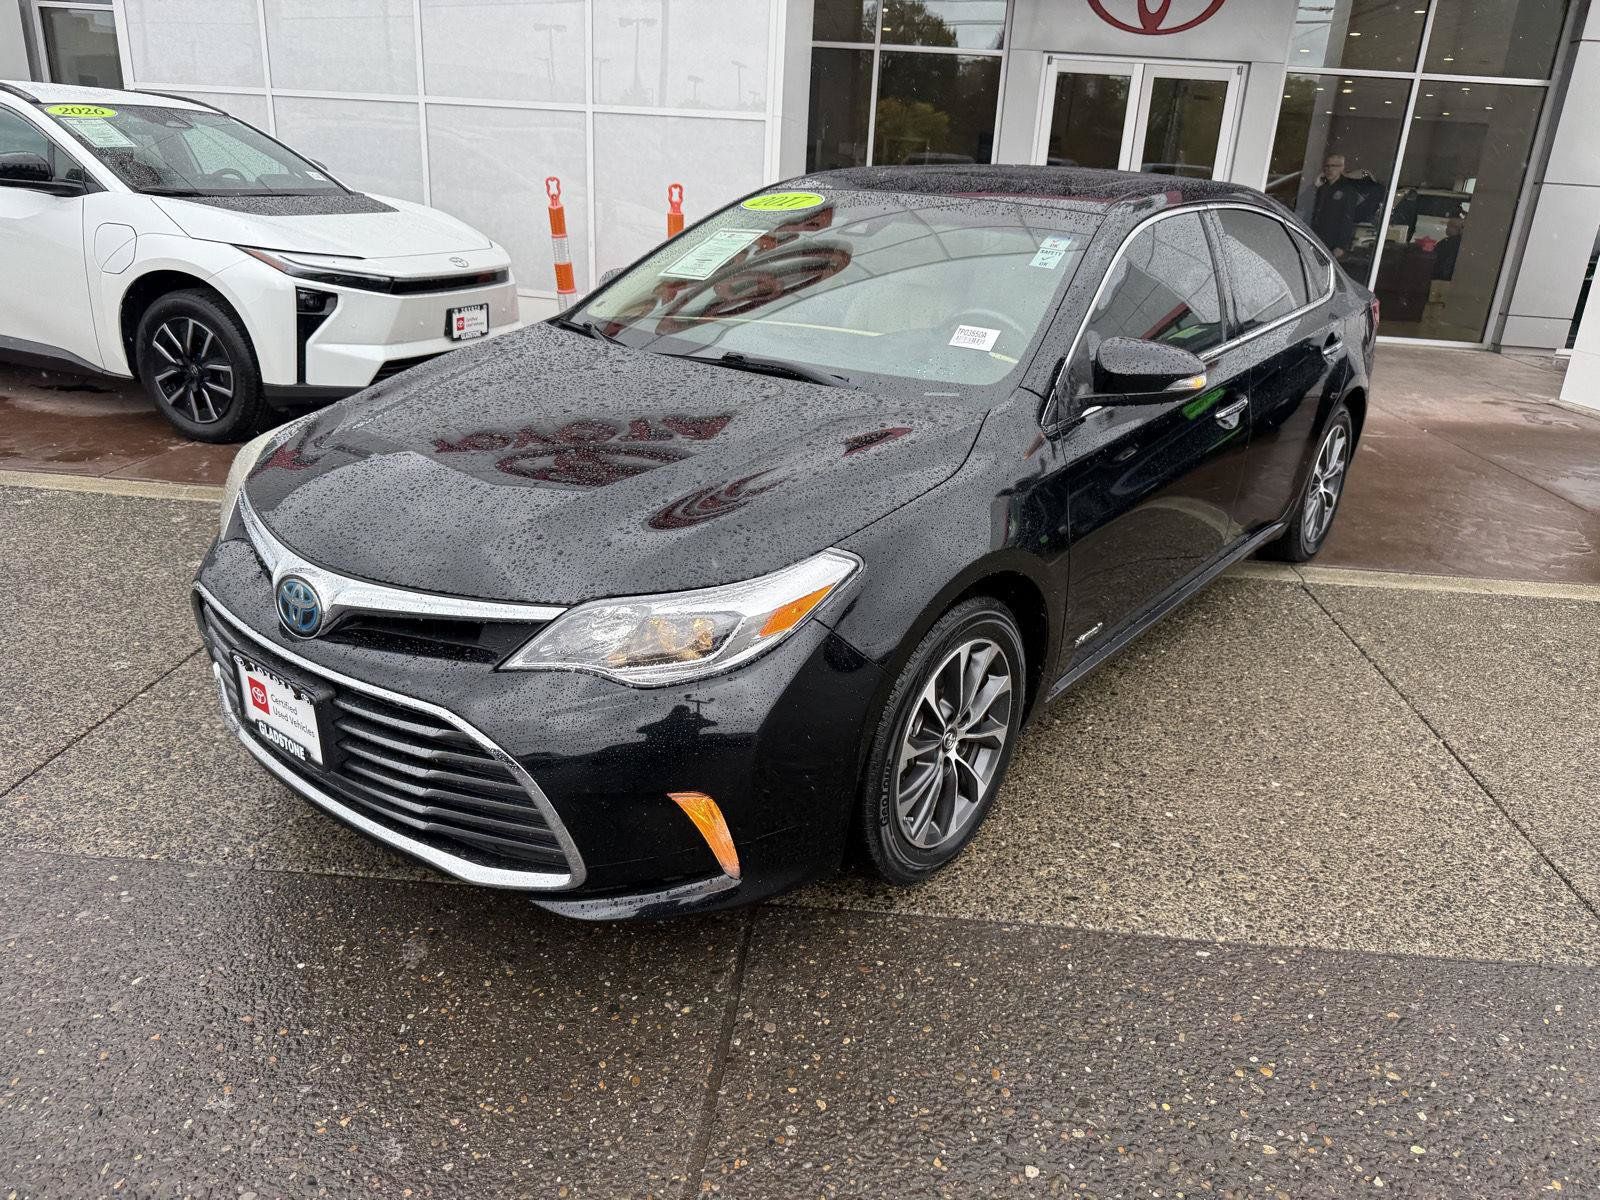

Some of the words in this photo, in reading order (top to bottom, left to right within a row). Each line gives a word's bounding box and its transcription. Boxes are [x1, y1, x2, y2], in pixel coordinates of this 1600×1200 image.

[58, 107, 105, 115] 2026
[749, 196, 815, 207] 2017
[271, 694, 298, 716] Certified
[272, 706, 289, 722] Used
[289, 714, 316, 738] Vehicles
[258, 721, 307, 761] GLADSTONE
